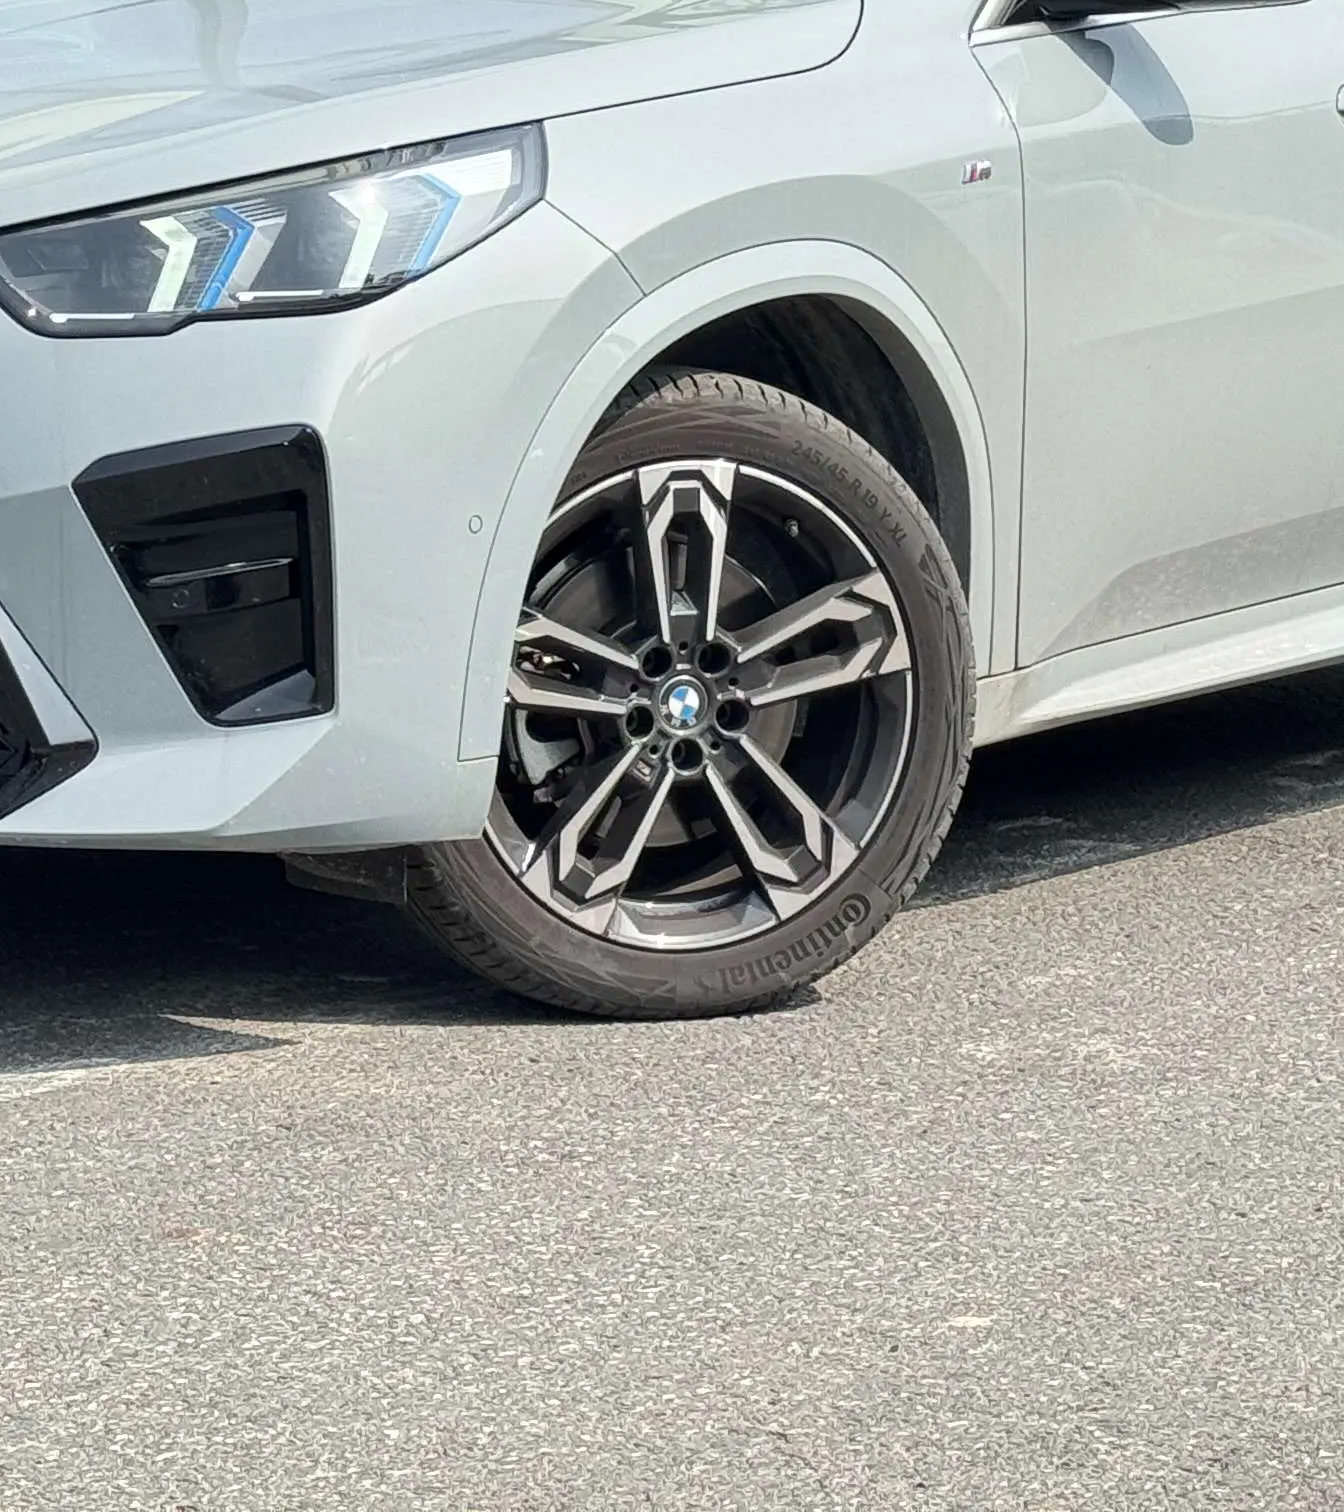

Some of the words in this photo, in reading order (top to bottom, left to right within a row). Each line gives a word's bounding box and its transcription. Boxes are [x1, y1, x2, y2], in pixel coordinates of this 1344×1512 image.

[790, 438, 850, 485] 245/45
[848, 474, 863, 496] R
[861, 487, 880, 511] 19
[716, 891, 873, 996] Continental
